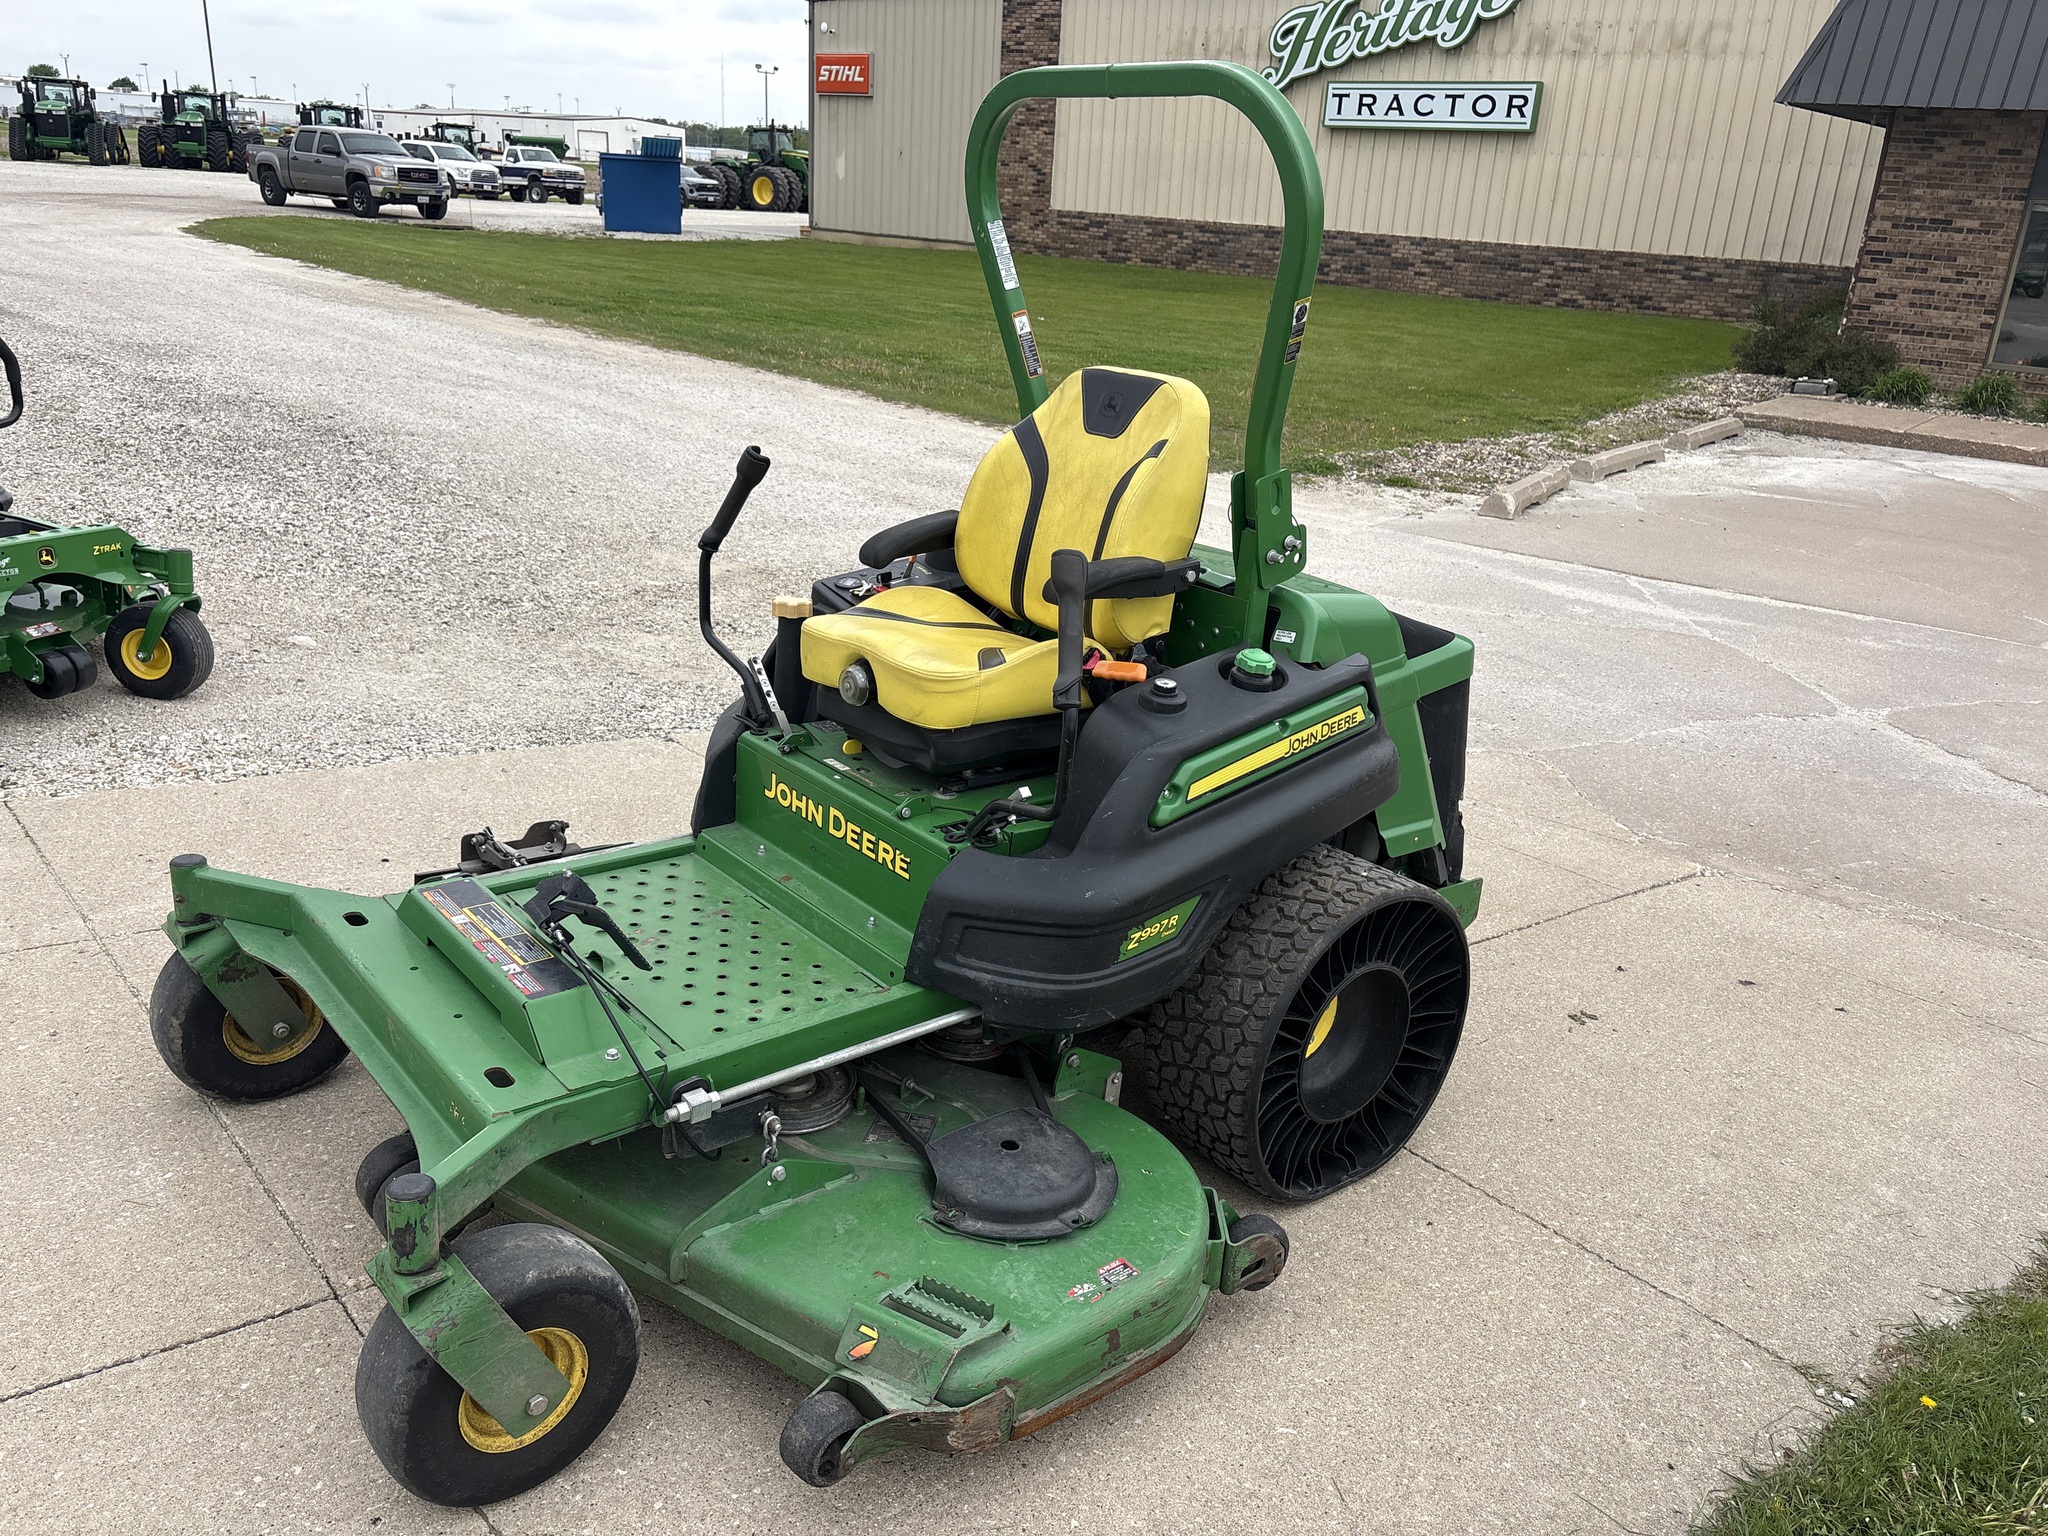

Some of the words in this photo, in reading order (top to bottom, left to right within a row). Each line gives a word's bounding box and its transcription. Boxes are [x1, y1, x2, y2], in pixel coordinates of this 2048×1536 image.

[817, 65, 865, 82] STIHL
[1331, 93, 1530, 119] TRACTOR
[93, 543, 122, 556] ZTRAK
[1284, 730, 1318, 756] JOHN
[1321, 712, 1358, 739] DEERE
[764, 772, 823, 829] JOHN
[828, 805, 911, 882] DEERE
[1126, 914, 1179, 951] Z997R
